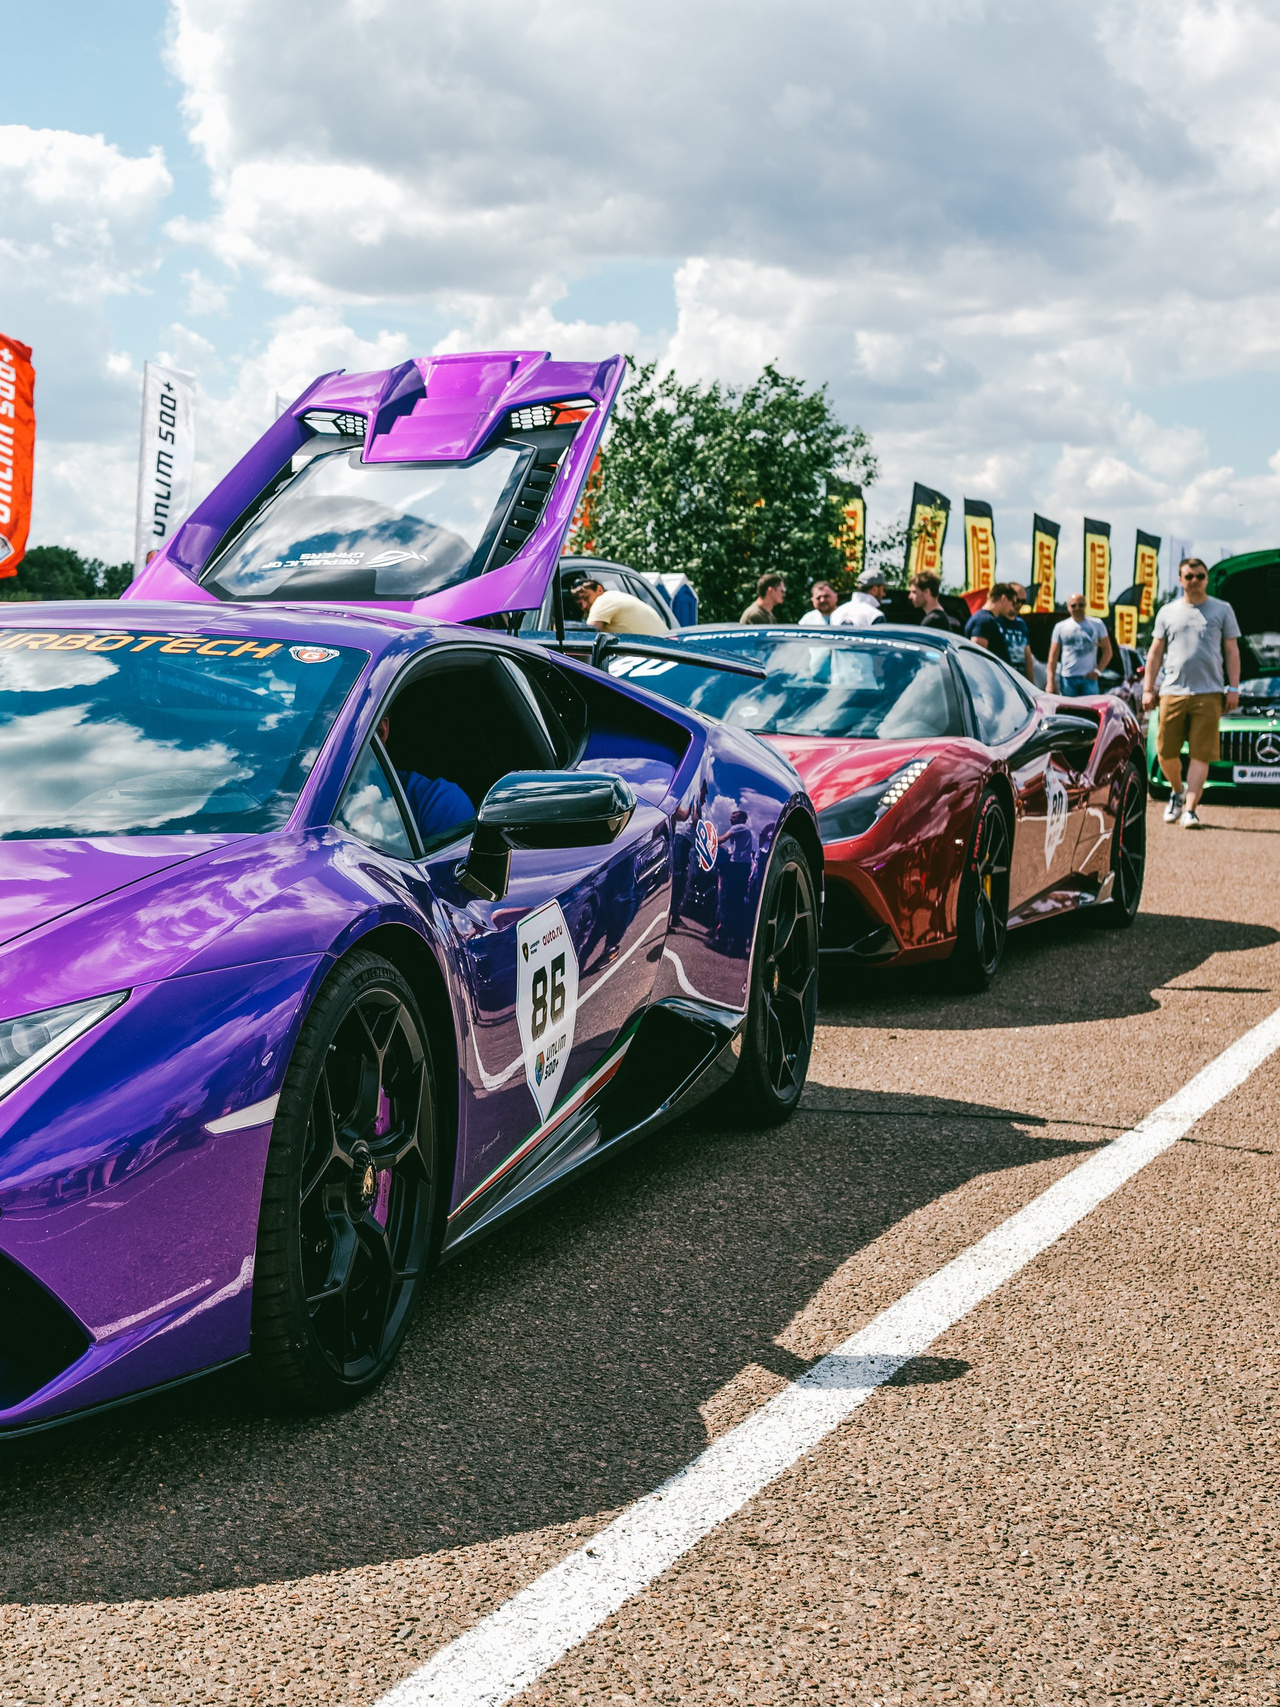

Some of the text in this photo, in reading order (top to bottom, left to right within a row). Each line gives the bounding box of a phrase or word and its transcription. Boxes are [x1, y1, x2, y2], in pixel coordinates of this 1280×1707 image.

[153, 381, 177, 537] UNLIM 500+
[285, 558, 360, 567] REPUBLIC
[300, 552, 366, 560] GAMERS
[1089, 542, 1105, 610] PIRELLI
[542, 925, 563, 946] auto.ru
[531, 952, 566, 1041] 86
[546, 1034, 566, 1061] UNLIM
[544, 1057, 559, 1081] 500+
